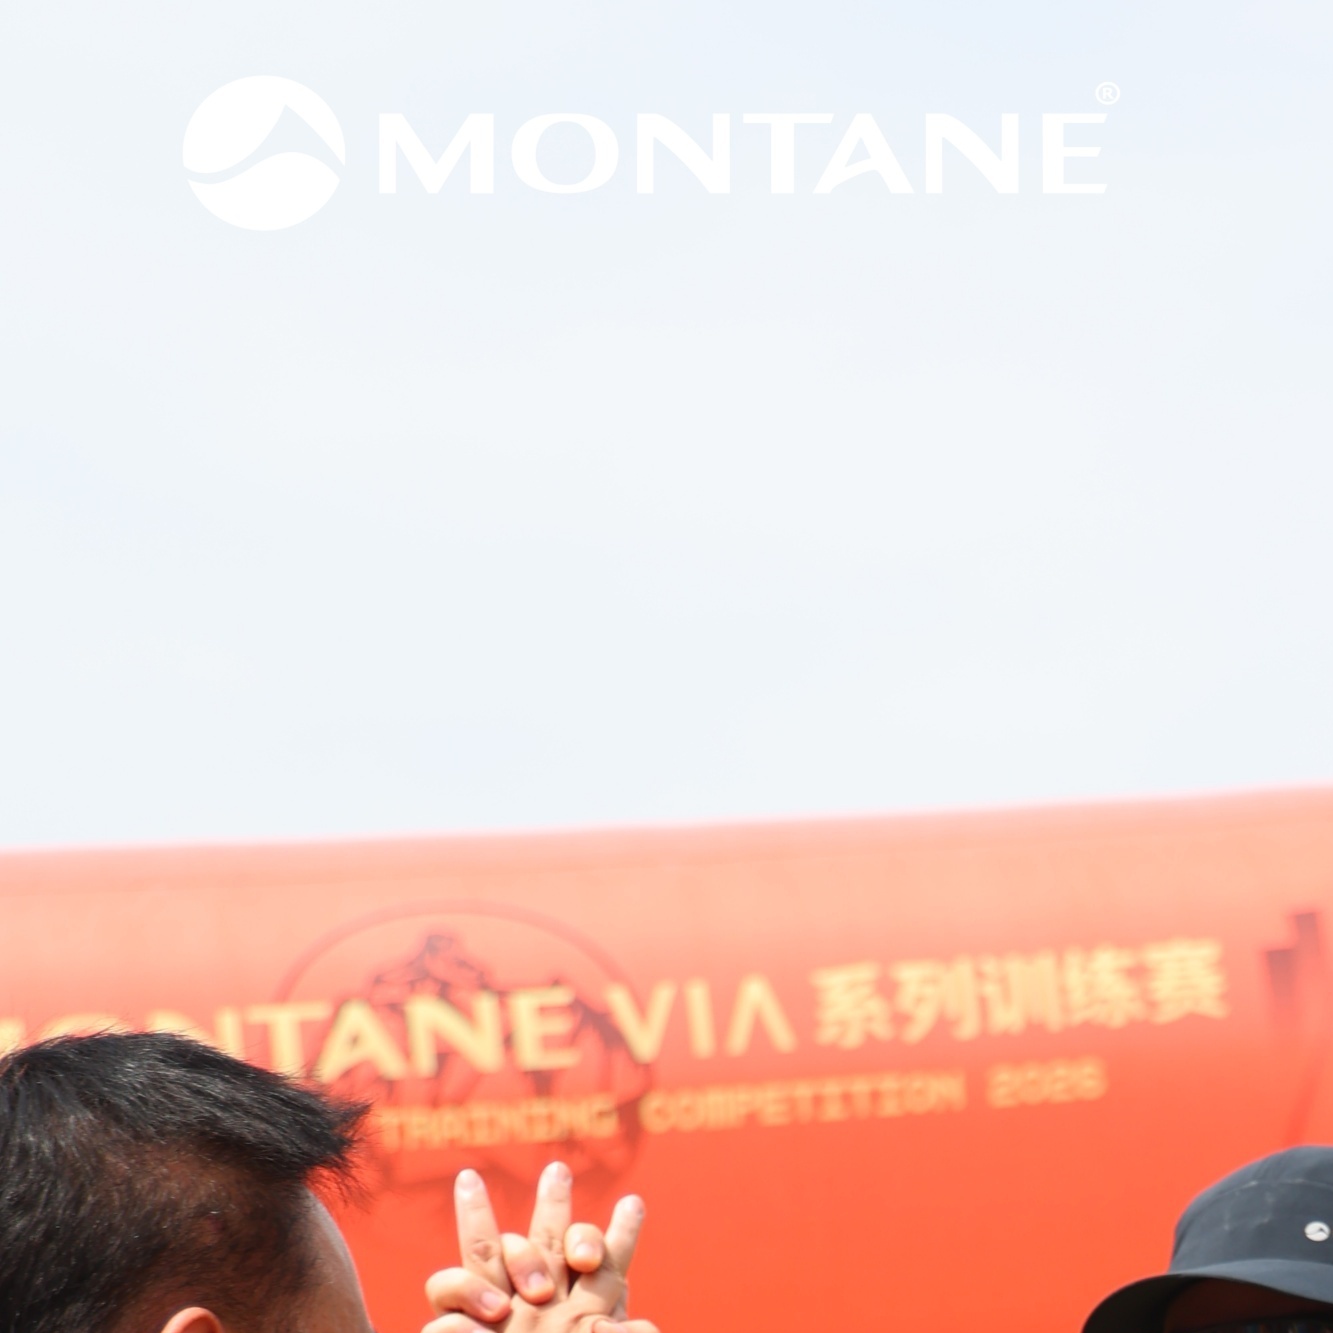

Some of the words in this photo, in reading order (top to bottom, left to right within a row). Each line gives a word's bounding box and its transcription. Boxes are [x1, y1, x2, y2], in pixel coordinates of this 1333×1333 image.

[0, 984, 582, 1083] TANE
[607, 974, 797, 1064] VIA
[810, 936, 1228, 1050] 系列训练赛
